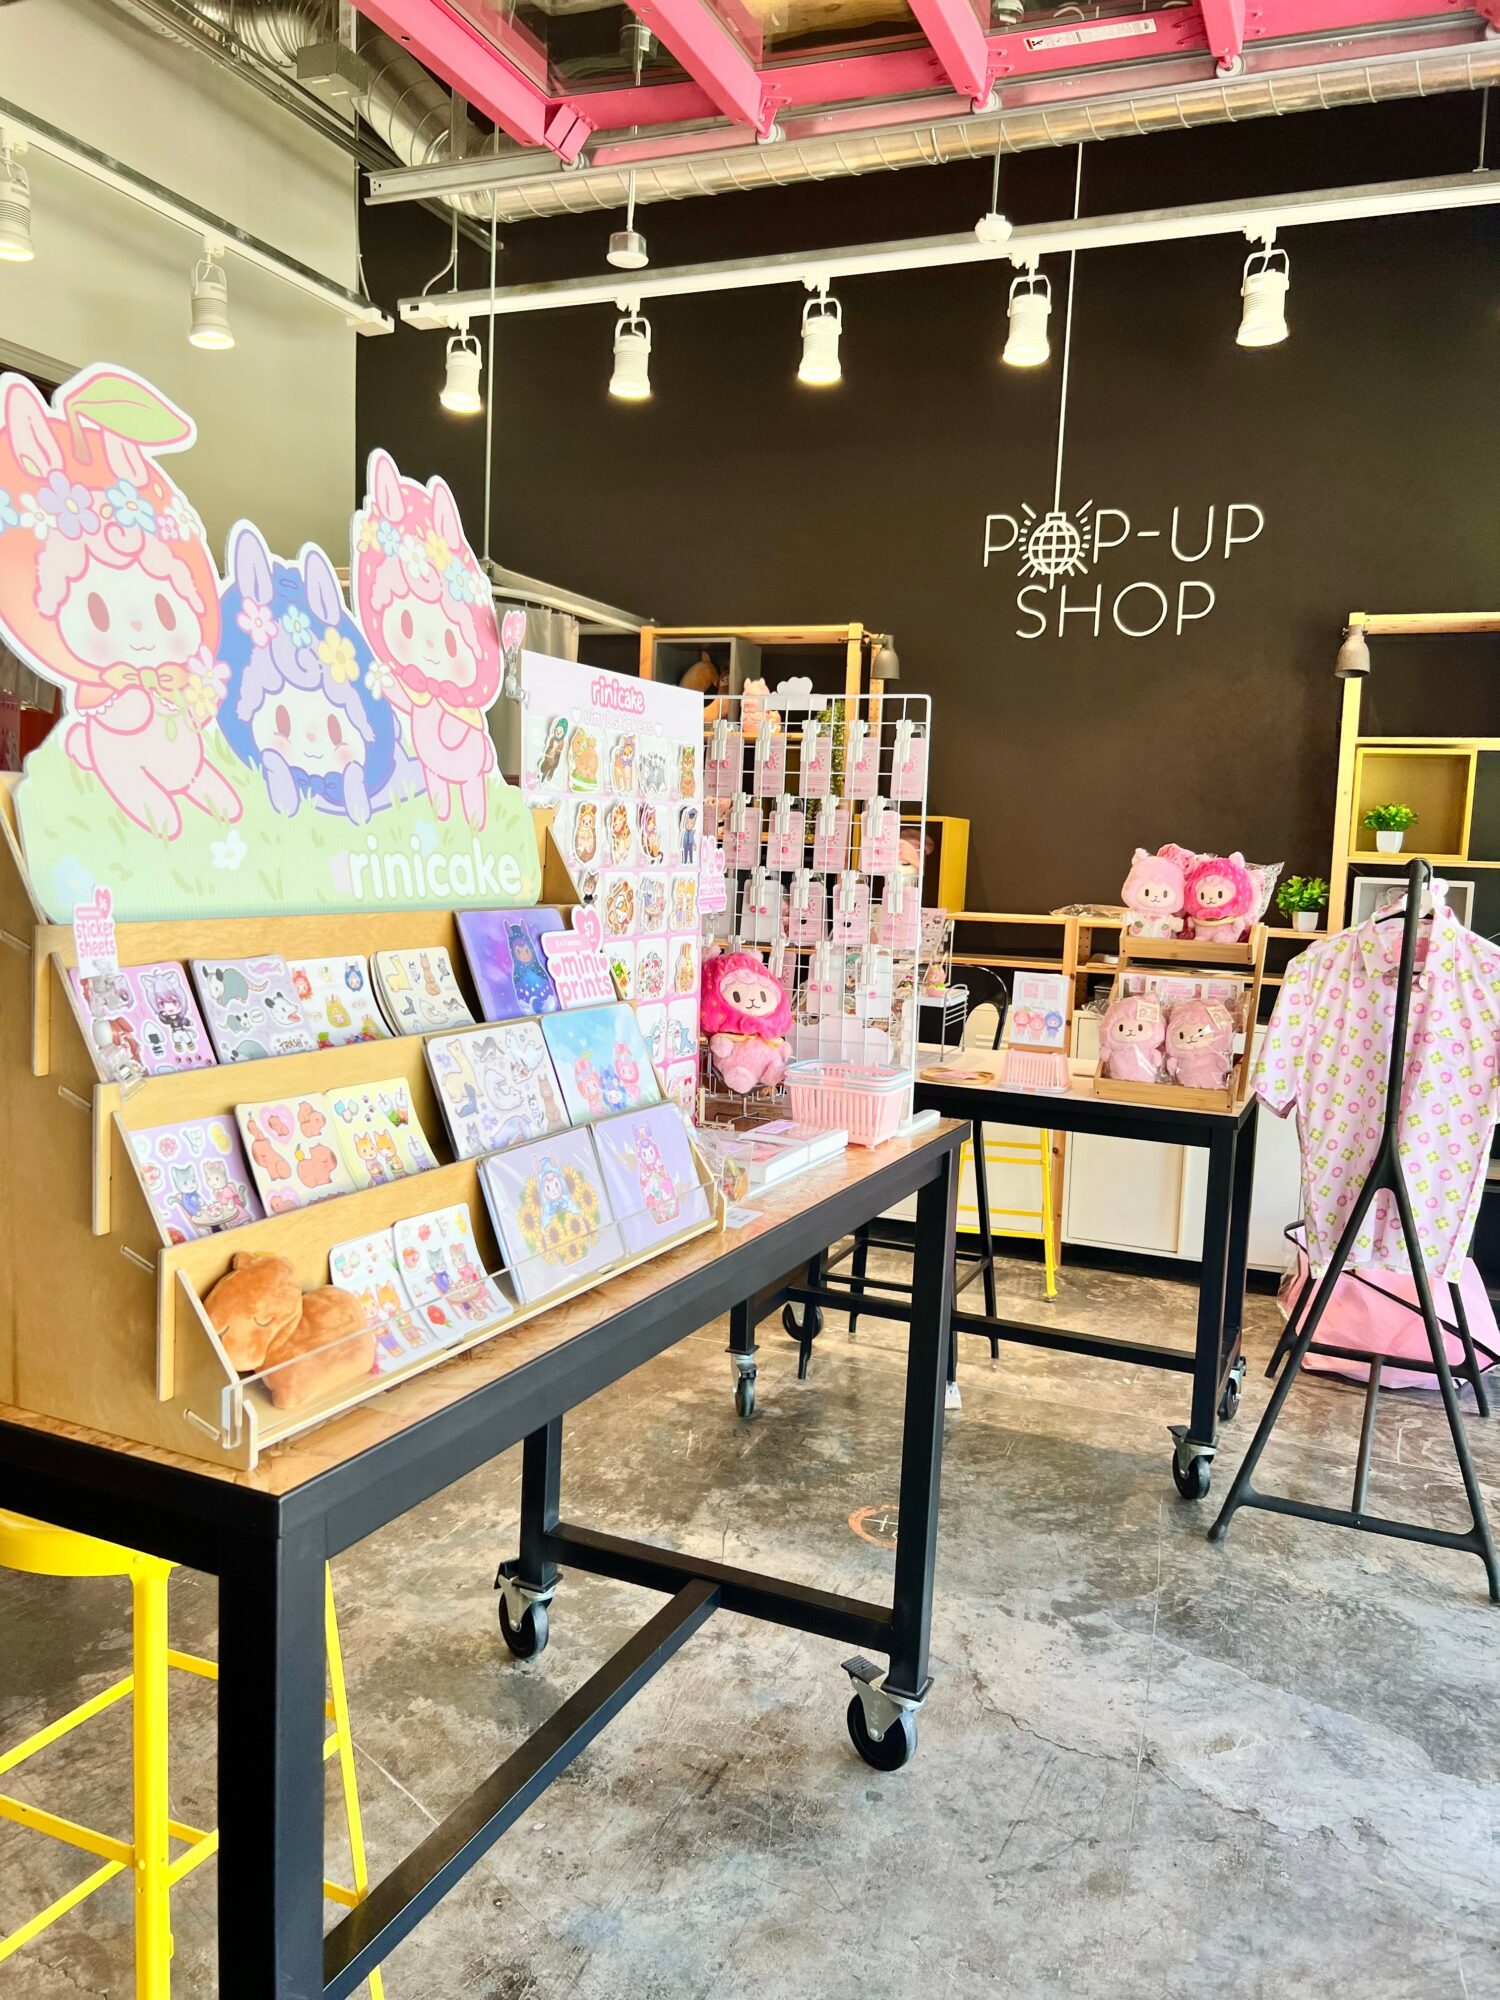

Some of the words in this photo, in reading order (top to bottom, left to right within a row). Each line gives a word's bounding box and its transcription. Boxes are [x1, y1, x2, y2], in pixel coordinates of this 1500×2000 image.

[984, 502, 1265, 574] POP-UP
[1016, 581, 1216, 639] SHOP
[591, 675, 645, 715] rinicake
[349, 834, 522, 900] rinicake
[76, 920, 113, 939] sticker
[79, 937, 115, 958] sheets
[561, 949, 600, 978] mini
[559, 972, 613, 1009] prints
[279, 1037, 304, 1051] TRASH
